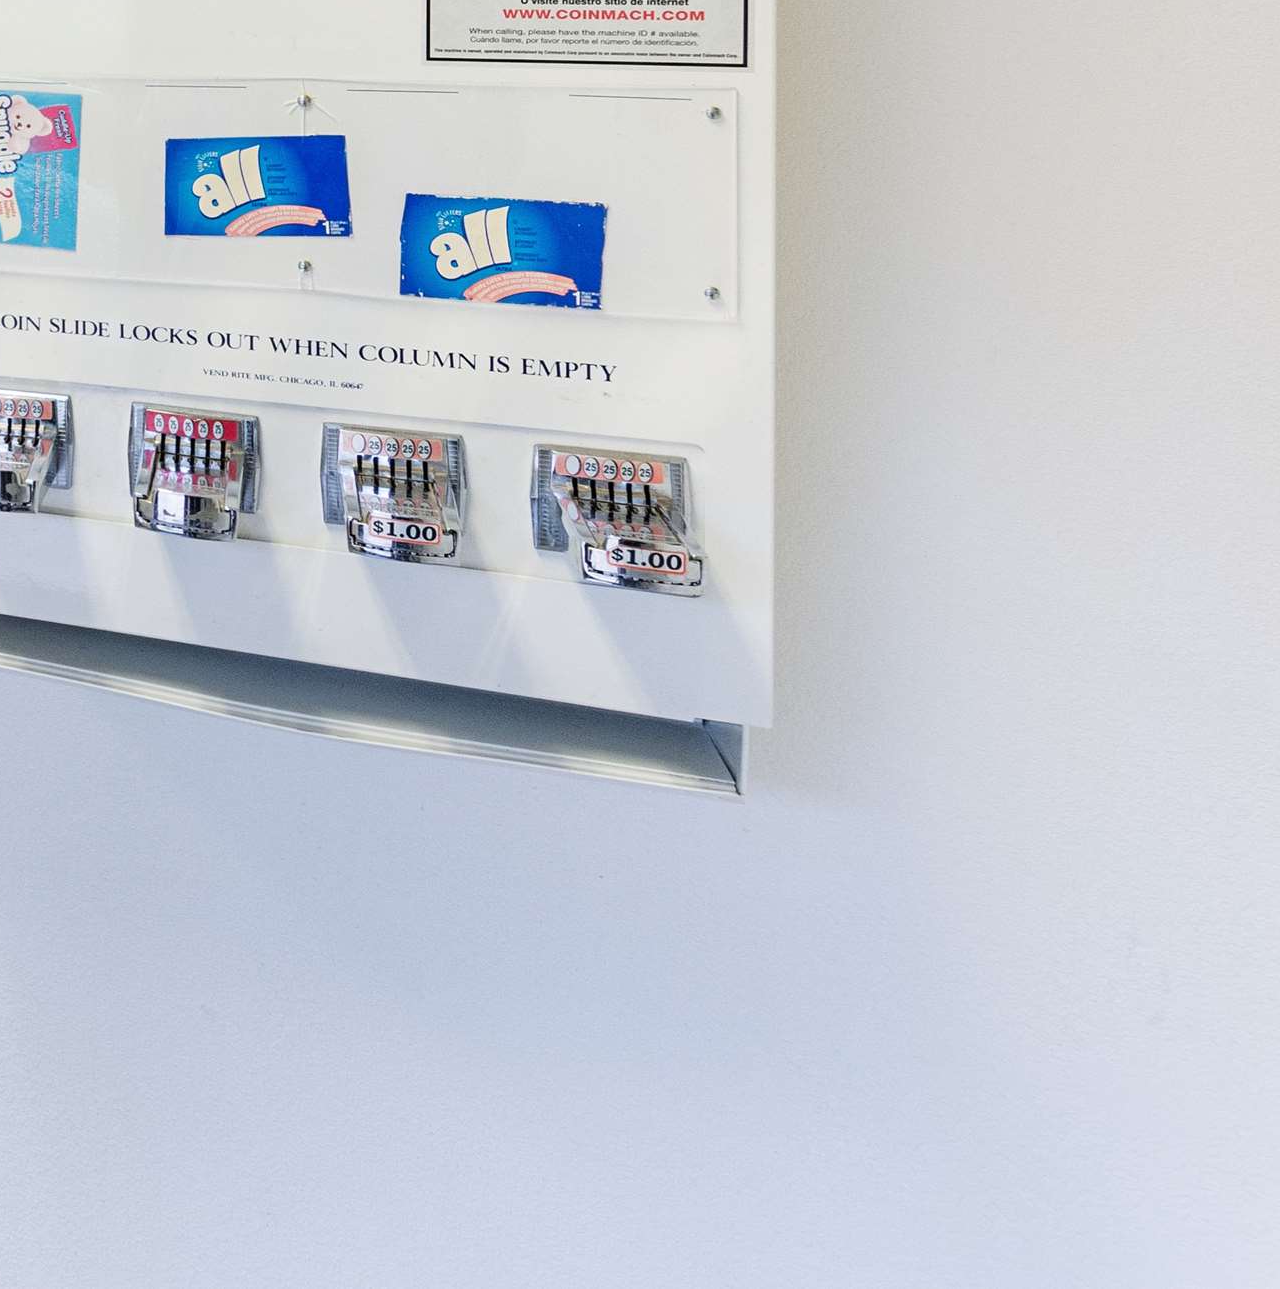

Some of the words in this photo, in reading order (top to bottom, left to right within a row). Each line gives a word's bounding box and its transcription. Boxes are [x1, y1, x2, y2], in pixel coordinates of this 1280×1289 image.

[503, 9, 706, 21] WWW.COINMACH.COM
[469, 27, 493, 35] When
[495, 28, 526, 37] calling,
[527, 28, 556, 38] please
[658, 30, 701, 38] available.
[561, 38, 590, 46] reporte
[192, 144, 267, 219] all
[429, 205, 512, 281] all
[49, 317, 110, 338] SLIDE
[119, 323, 198, 345] LOCKS
[207, 330, 260, 351] OUT
[269, 336, 348, 360] WHEN
[359, 344, 476, 371] COLUMN
[489, 355, 510, 373] IS
[521, 358, 617, 383] EMPTY
[203, 368, 229, 377] VEND
[230, 371, 250, 380] RITE
[369, 440, 380, 449] 25
[386, 443, 397, 452] 25
[402, 444, 413, 454] 25
[418, 445, 429, 455] 25
[585, 462, 597, 472] 25
[603, 464, 615, 474] 25
[621, 466, 633, 476] 25
[640, 467, 651, 478] 25
[372, 520, 437, 542] $1.00
[611, 548, 682, 570] $1.00
